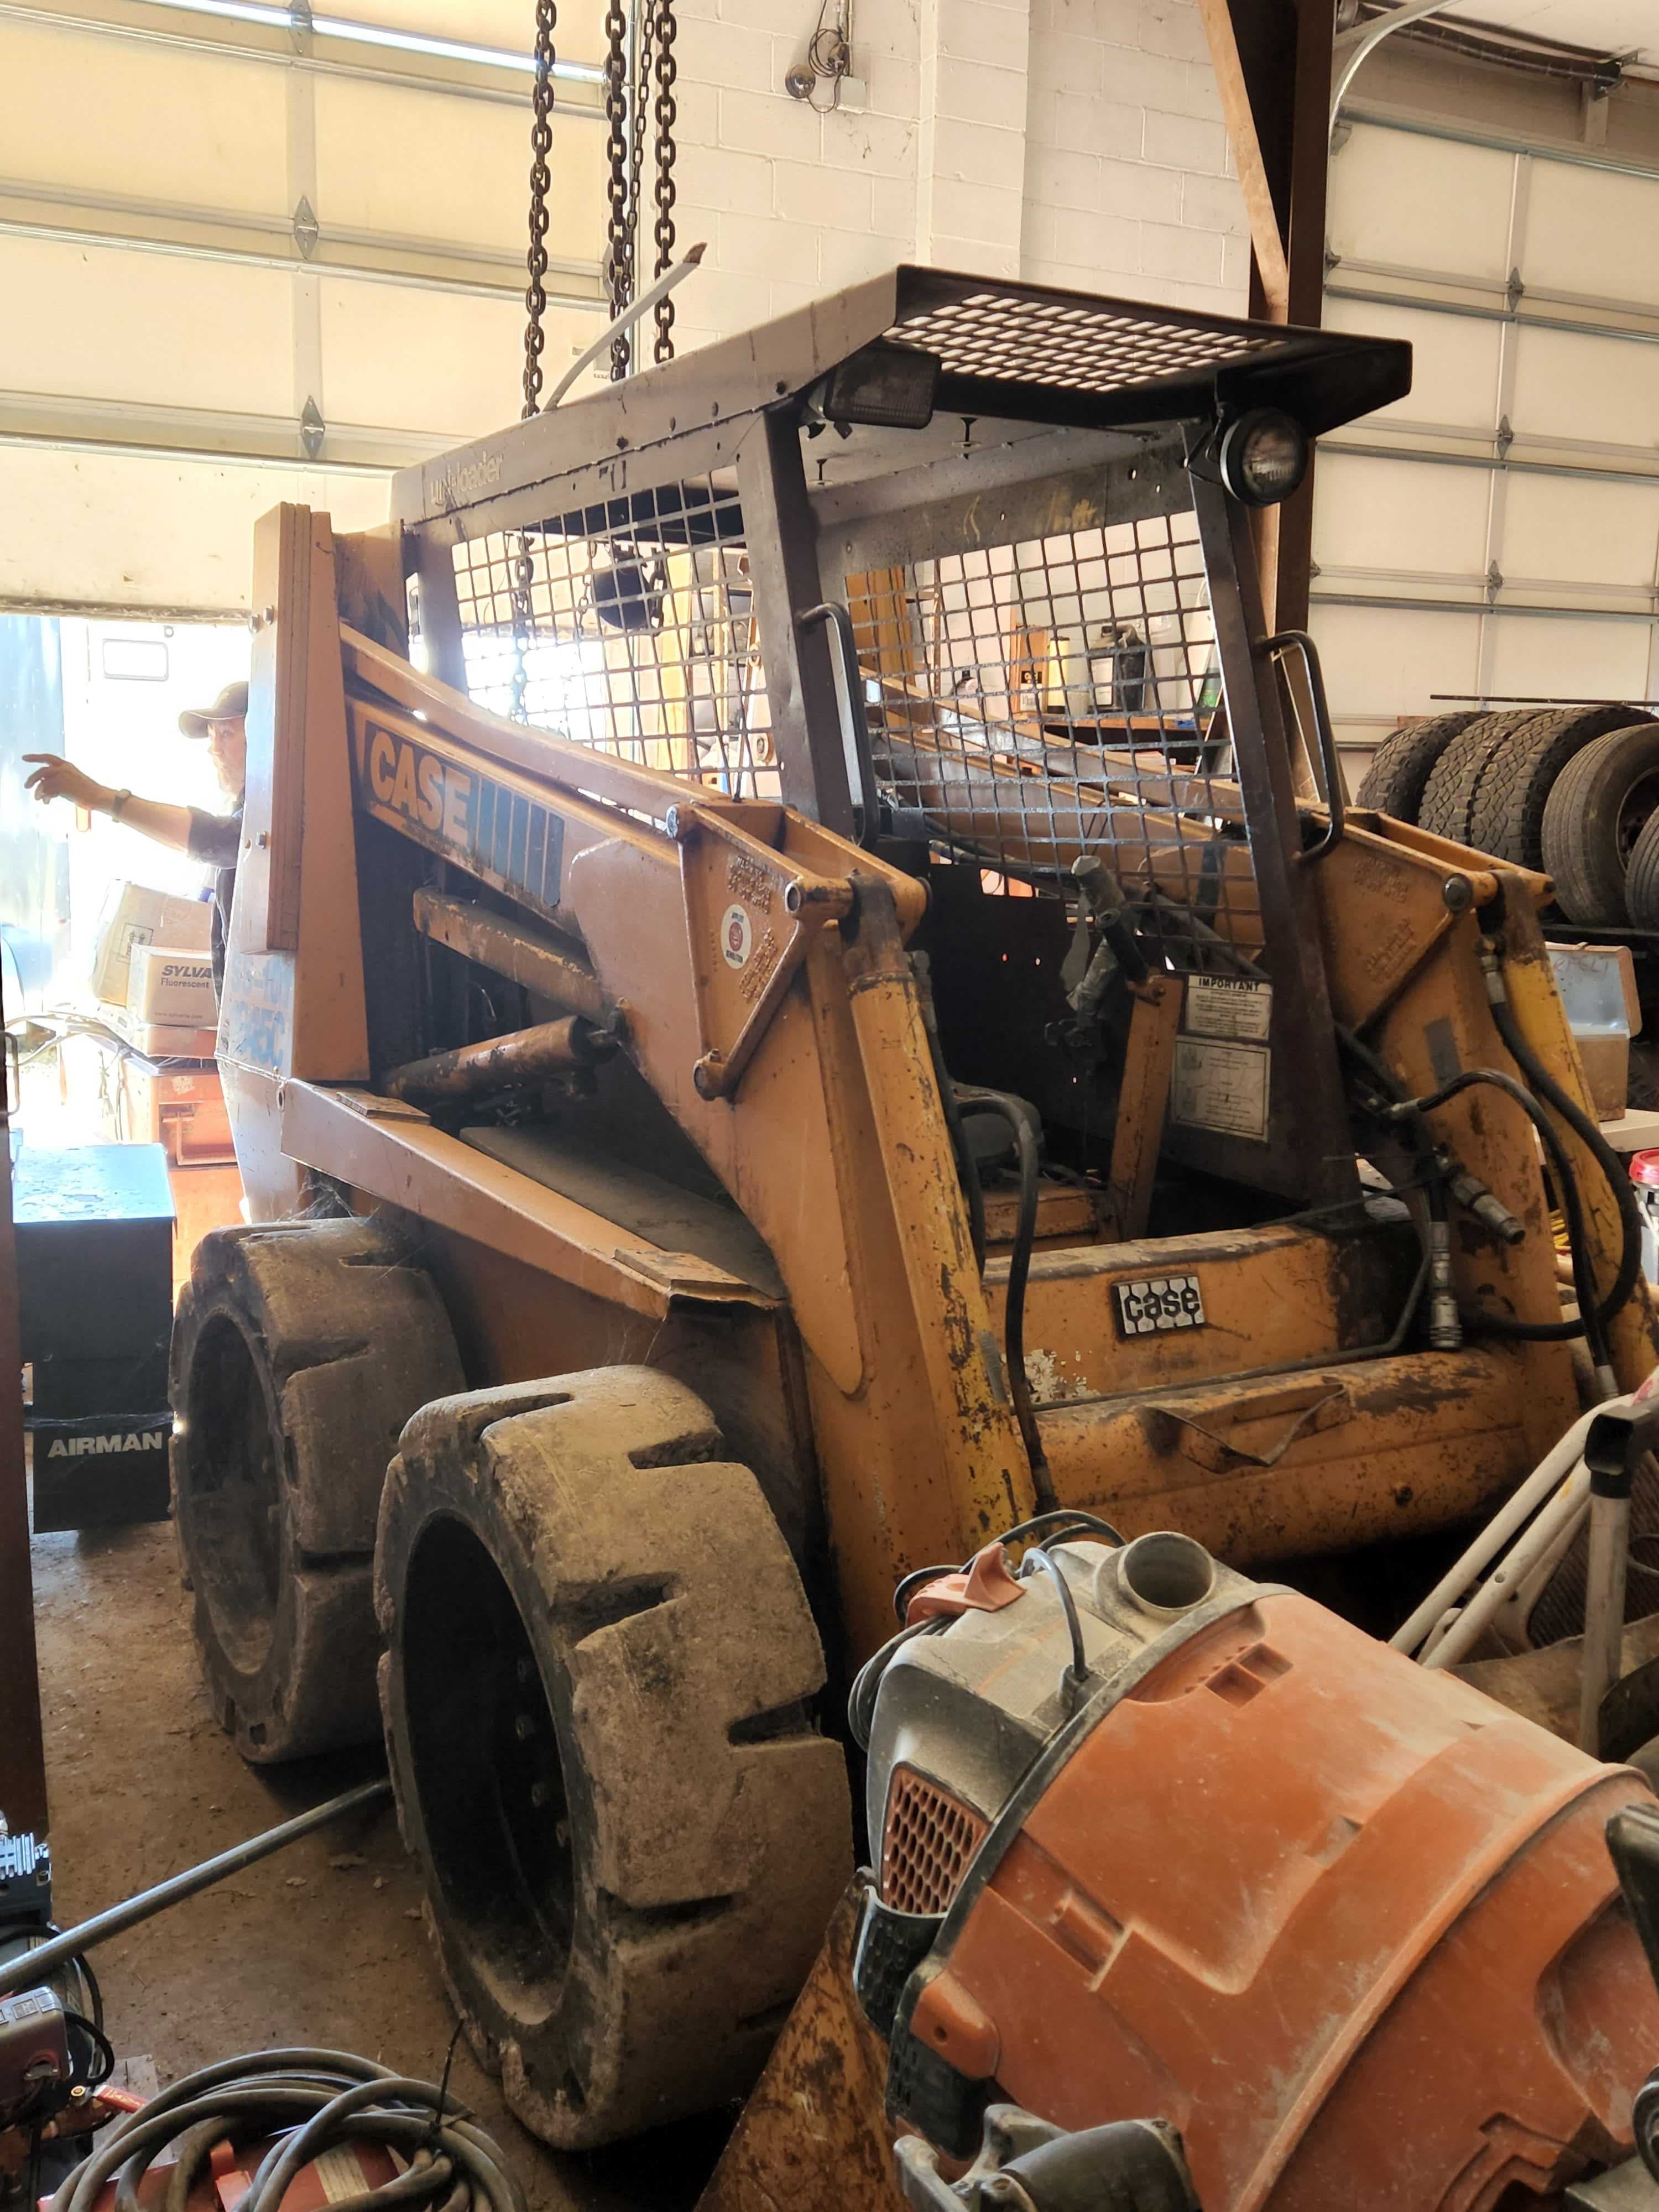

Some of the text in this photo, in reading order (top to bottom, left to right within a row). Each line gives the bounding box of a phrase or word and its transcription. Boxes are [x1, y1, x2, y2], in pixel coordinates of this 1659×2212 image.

[371, 730, 471, 847] CASE
[161, 965, 212, 978] SYLVA
[161, 977, 209, 988] Fluorescent
[1199, 977, 1259, 992] IMPORTANT
[48, 1432, 163, 1458] AIRMAN
